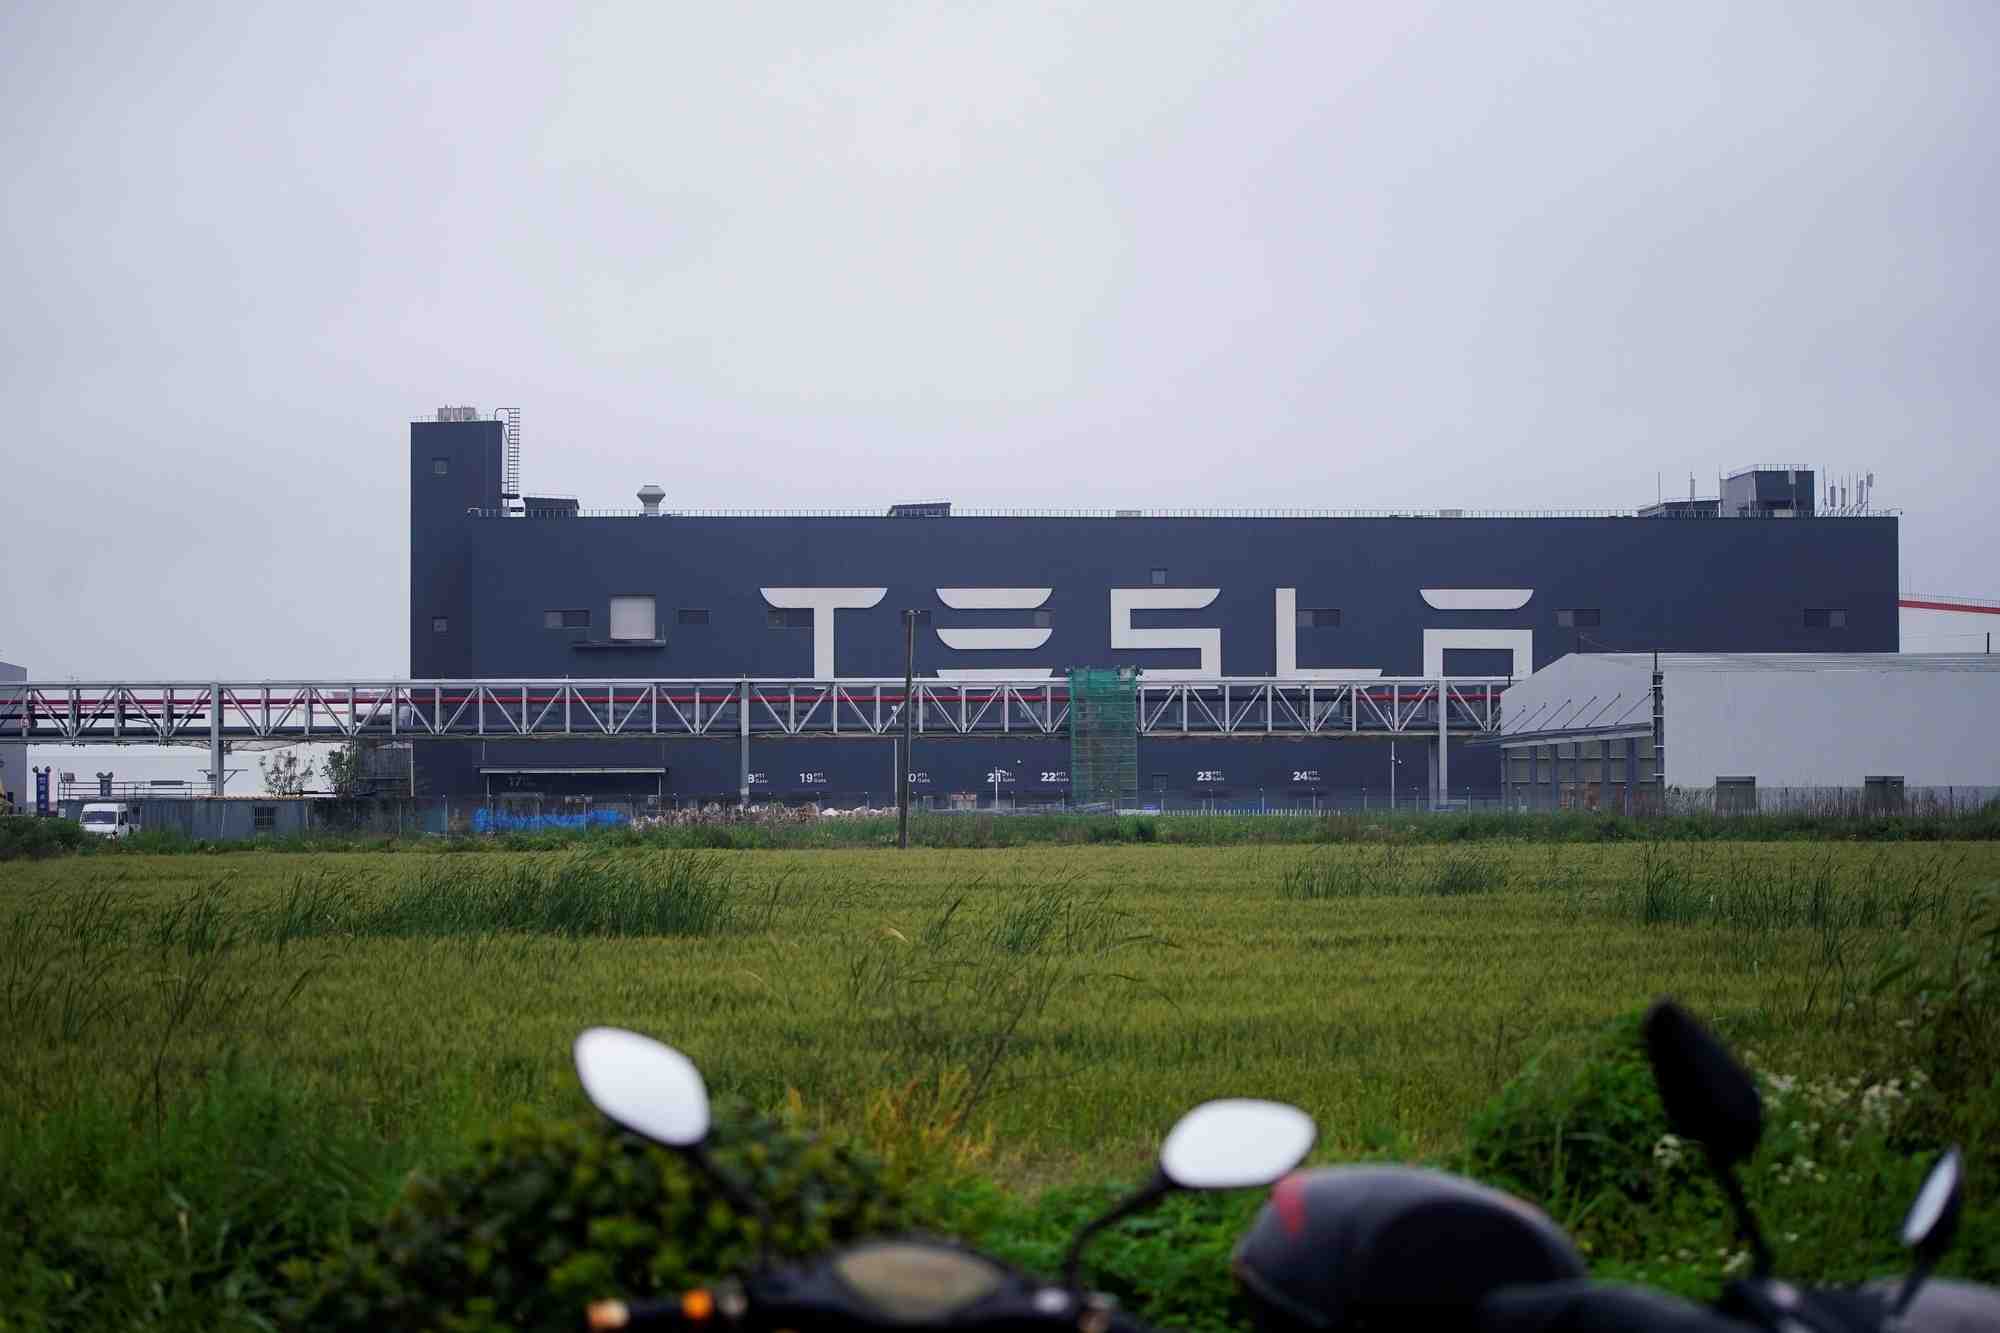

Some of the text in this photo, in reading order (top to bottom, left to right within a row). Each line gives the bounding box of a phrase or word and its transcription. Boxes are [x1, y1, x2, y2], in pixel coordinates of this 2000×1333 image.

[760, 587, 1534, 689] TESLA
[800, 773, 813, 783] 19
[1041, 772, 1056, 782] 22
[1197, 771, 1212, 781] 23
[1293, 771, 1308, 781] 24
